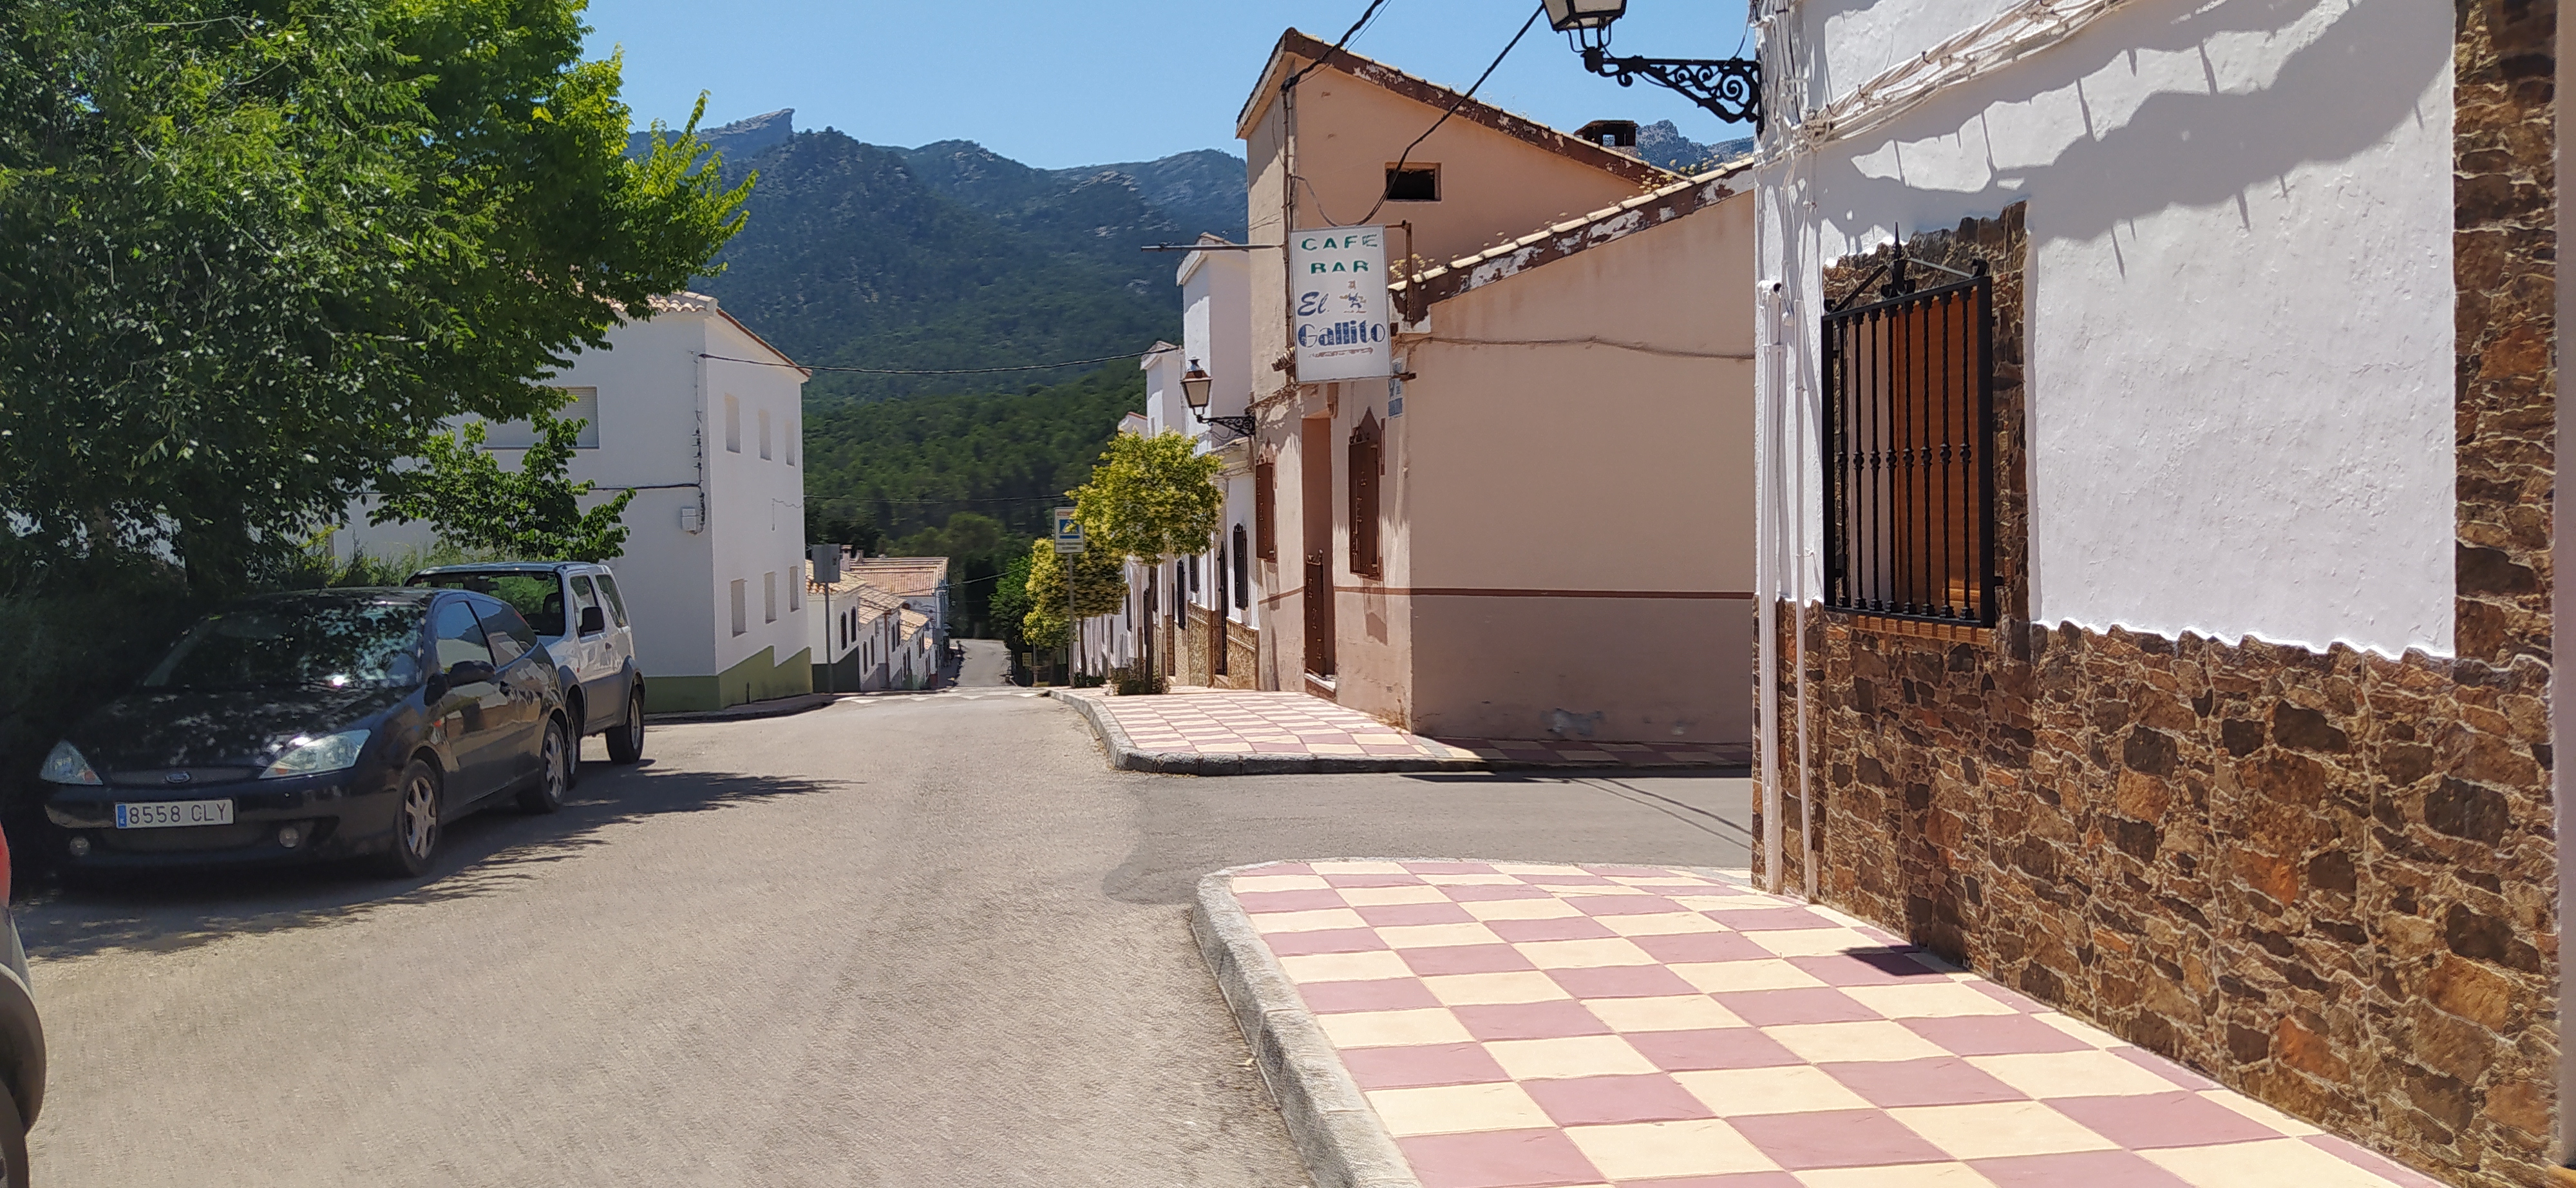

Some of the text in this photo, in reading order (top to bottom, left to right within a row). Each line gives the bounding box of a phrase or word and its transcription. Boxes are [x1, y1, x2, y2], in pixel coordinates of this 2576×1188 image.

[1301, 233, 1378, 251] CAFE
[1311, 260, 1369, 274] BAR
[1298, 320, 1386, 348] Gallito
[129, 803, 226, 825] 8558 CLY
